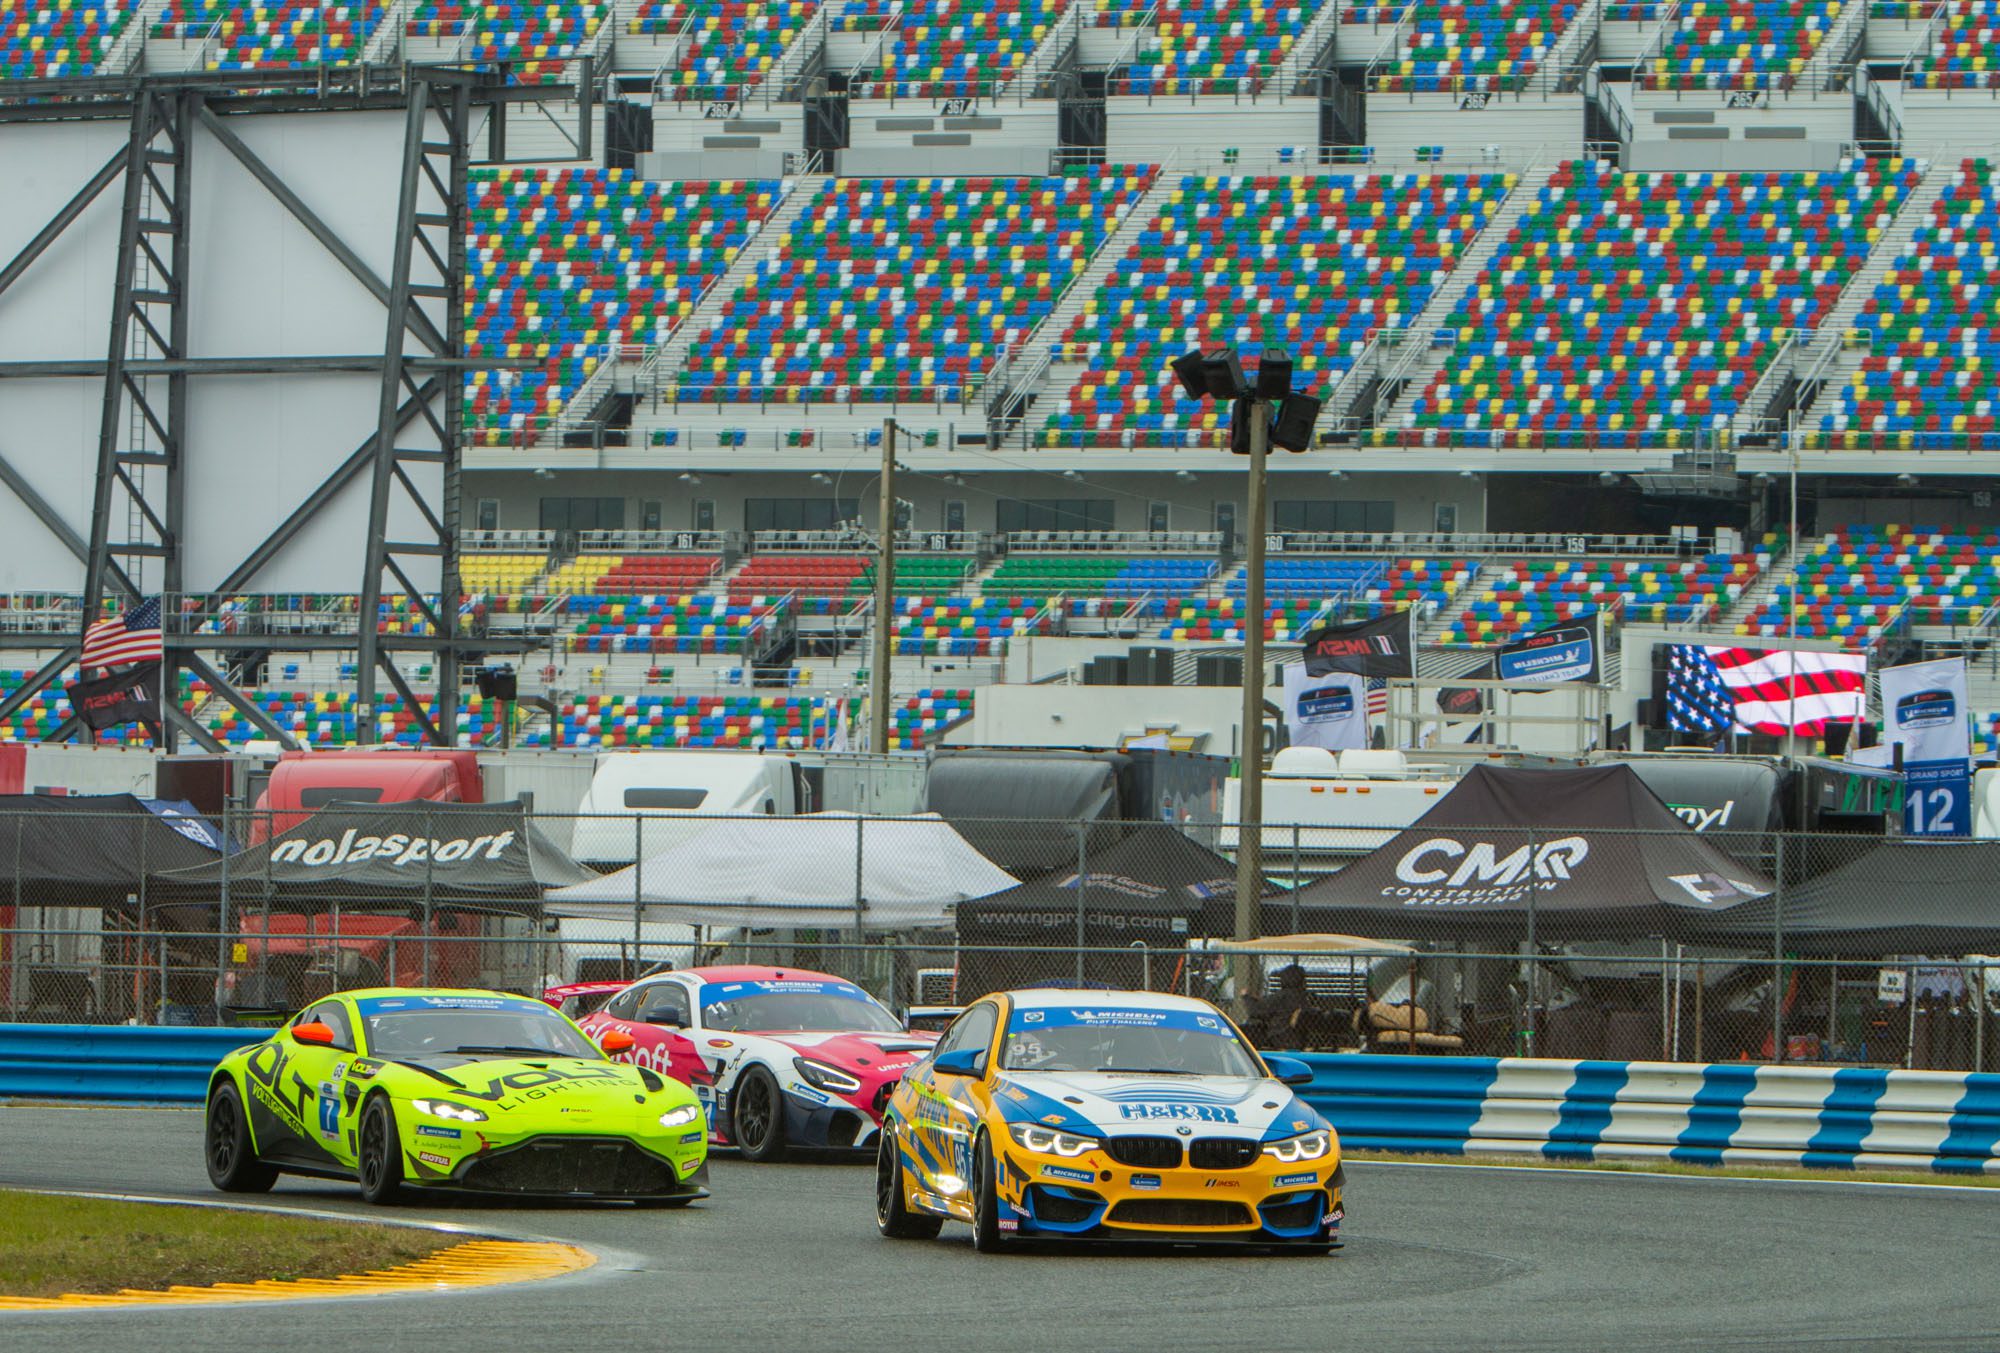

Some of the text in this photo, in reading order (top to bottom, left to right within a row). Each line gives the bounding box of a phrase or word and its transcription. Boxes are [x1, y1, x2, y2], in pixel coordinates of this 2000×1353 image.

[946, 100, 964, 114] 367
[1465, 94, 1486, 109] 366
[1734, 92, 1753, 107] 365
[710, 103, 729, 117] 368
[677, 533, 693, 549] 161
[930, 534, 946, 550] 161
[1264, 535, 1283, 551] 160
[1567, 536, 1585, 553] 159
[1910, 771, 1939, 780] GRAND
[1940, 767, 1965, 778] SPORT
[1906, 787, 1955, 833] 12
[271, 828, 516, 866] nolasport
[371, 1018, 380, 1028] 7
[1085, 1018, 1158, 1026] PILOT CHALLENGE
[1097, 1011, 1167, 1020] MICHELIN
[1011, 1043, 1042, 1061] 95
[448, 1069, 622, 1102] VOLT
[496, 1079, 639, 1112] LIGHTING
[325, 1099, 335, 1130] 7
[420, 1152, 449, 1165] MOTUL
[954, 1142, 968, 1180] 95
[1052, 1168, 1091, 1180] MICHELIN
[1283, 1175, 1315, 1184] MICHELIN
[1216, 1180, 1241, 1188] IMSA
